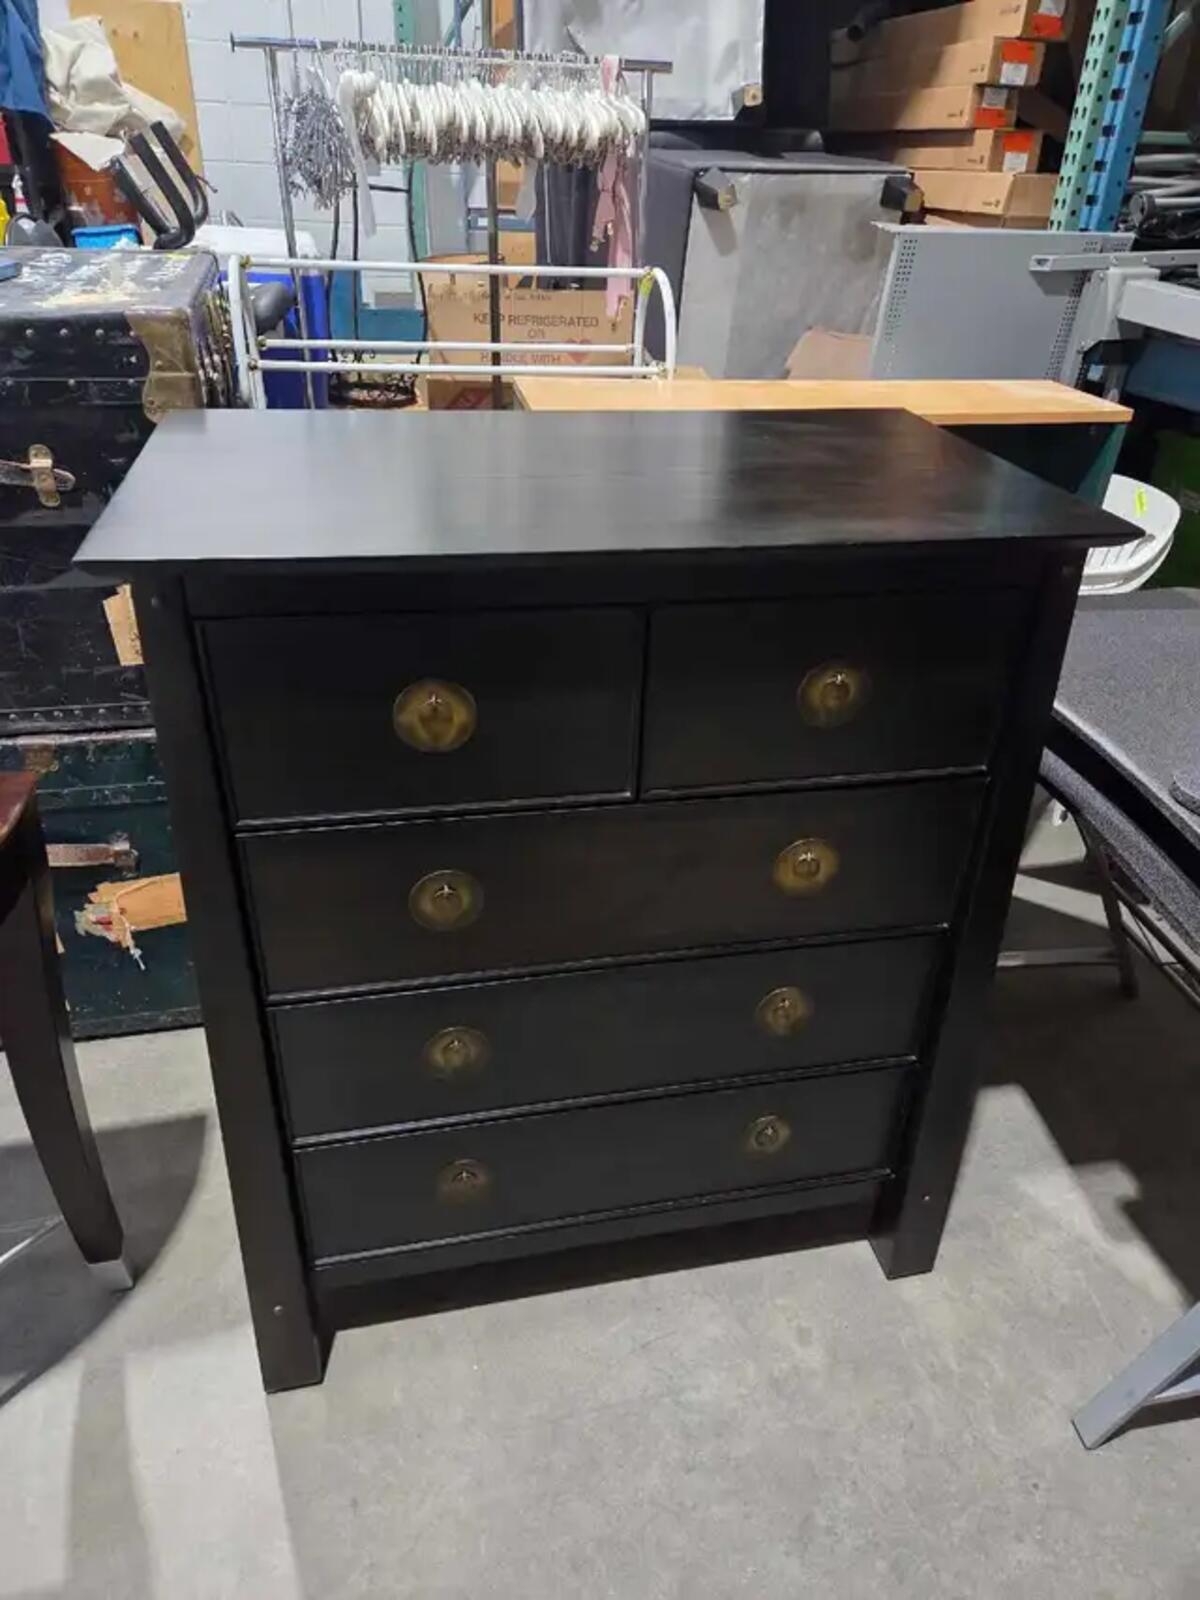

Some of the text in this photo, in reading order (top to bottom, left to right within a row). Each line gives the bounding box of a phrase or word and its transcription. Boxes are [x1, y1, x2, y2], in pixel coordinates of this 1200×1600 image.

[473, 312, 600, 328] KEP REFRIGERATED
[481, 352, 527, 364] HNDLE
